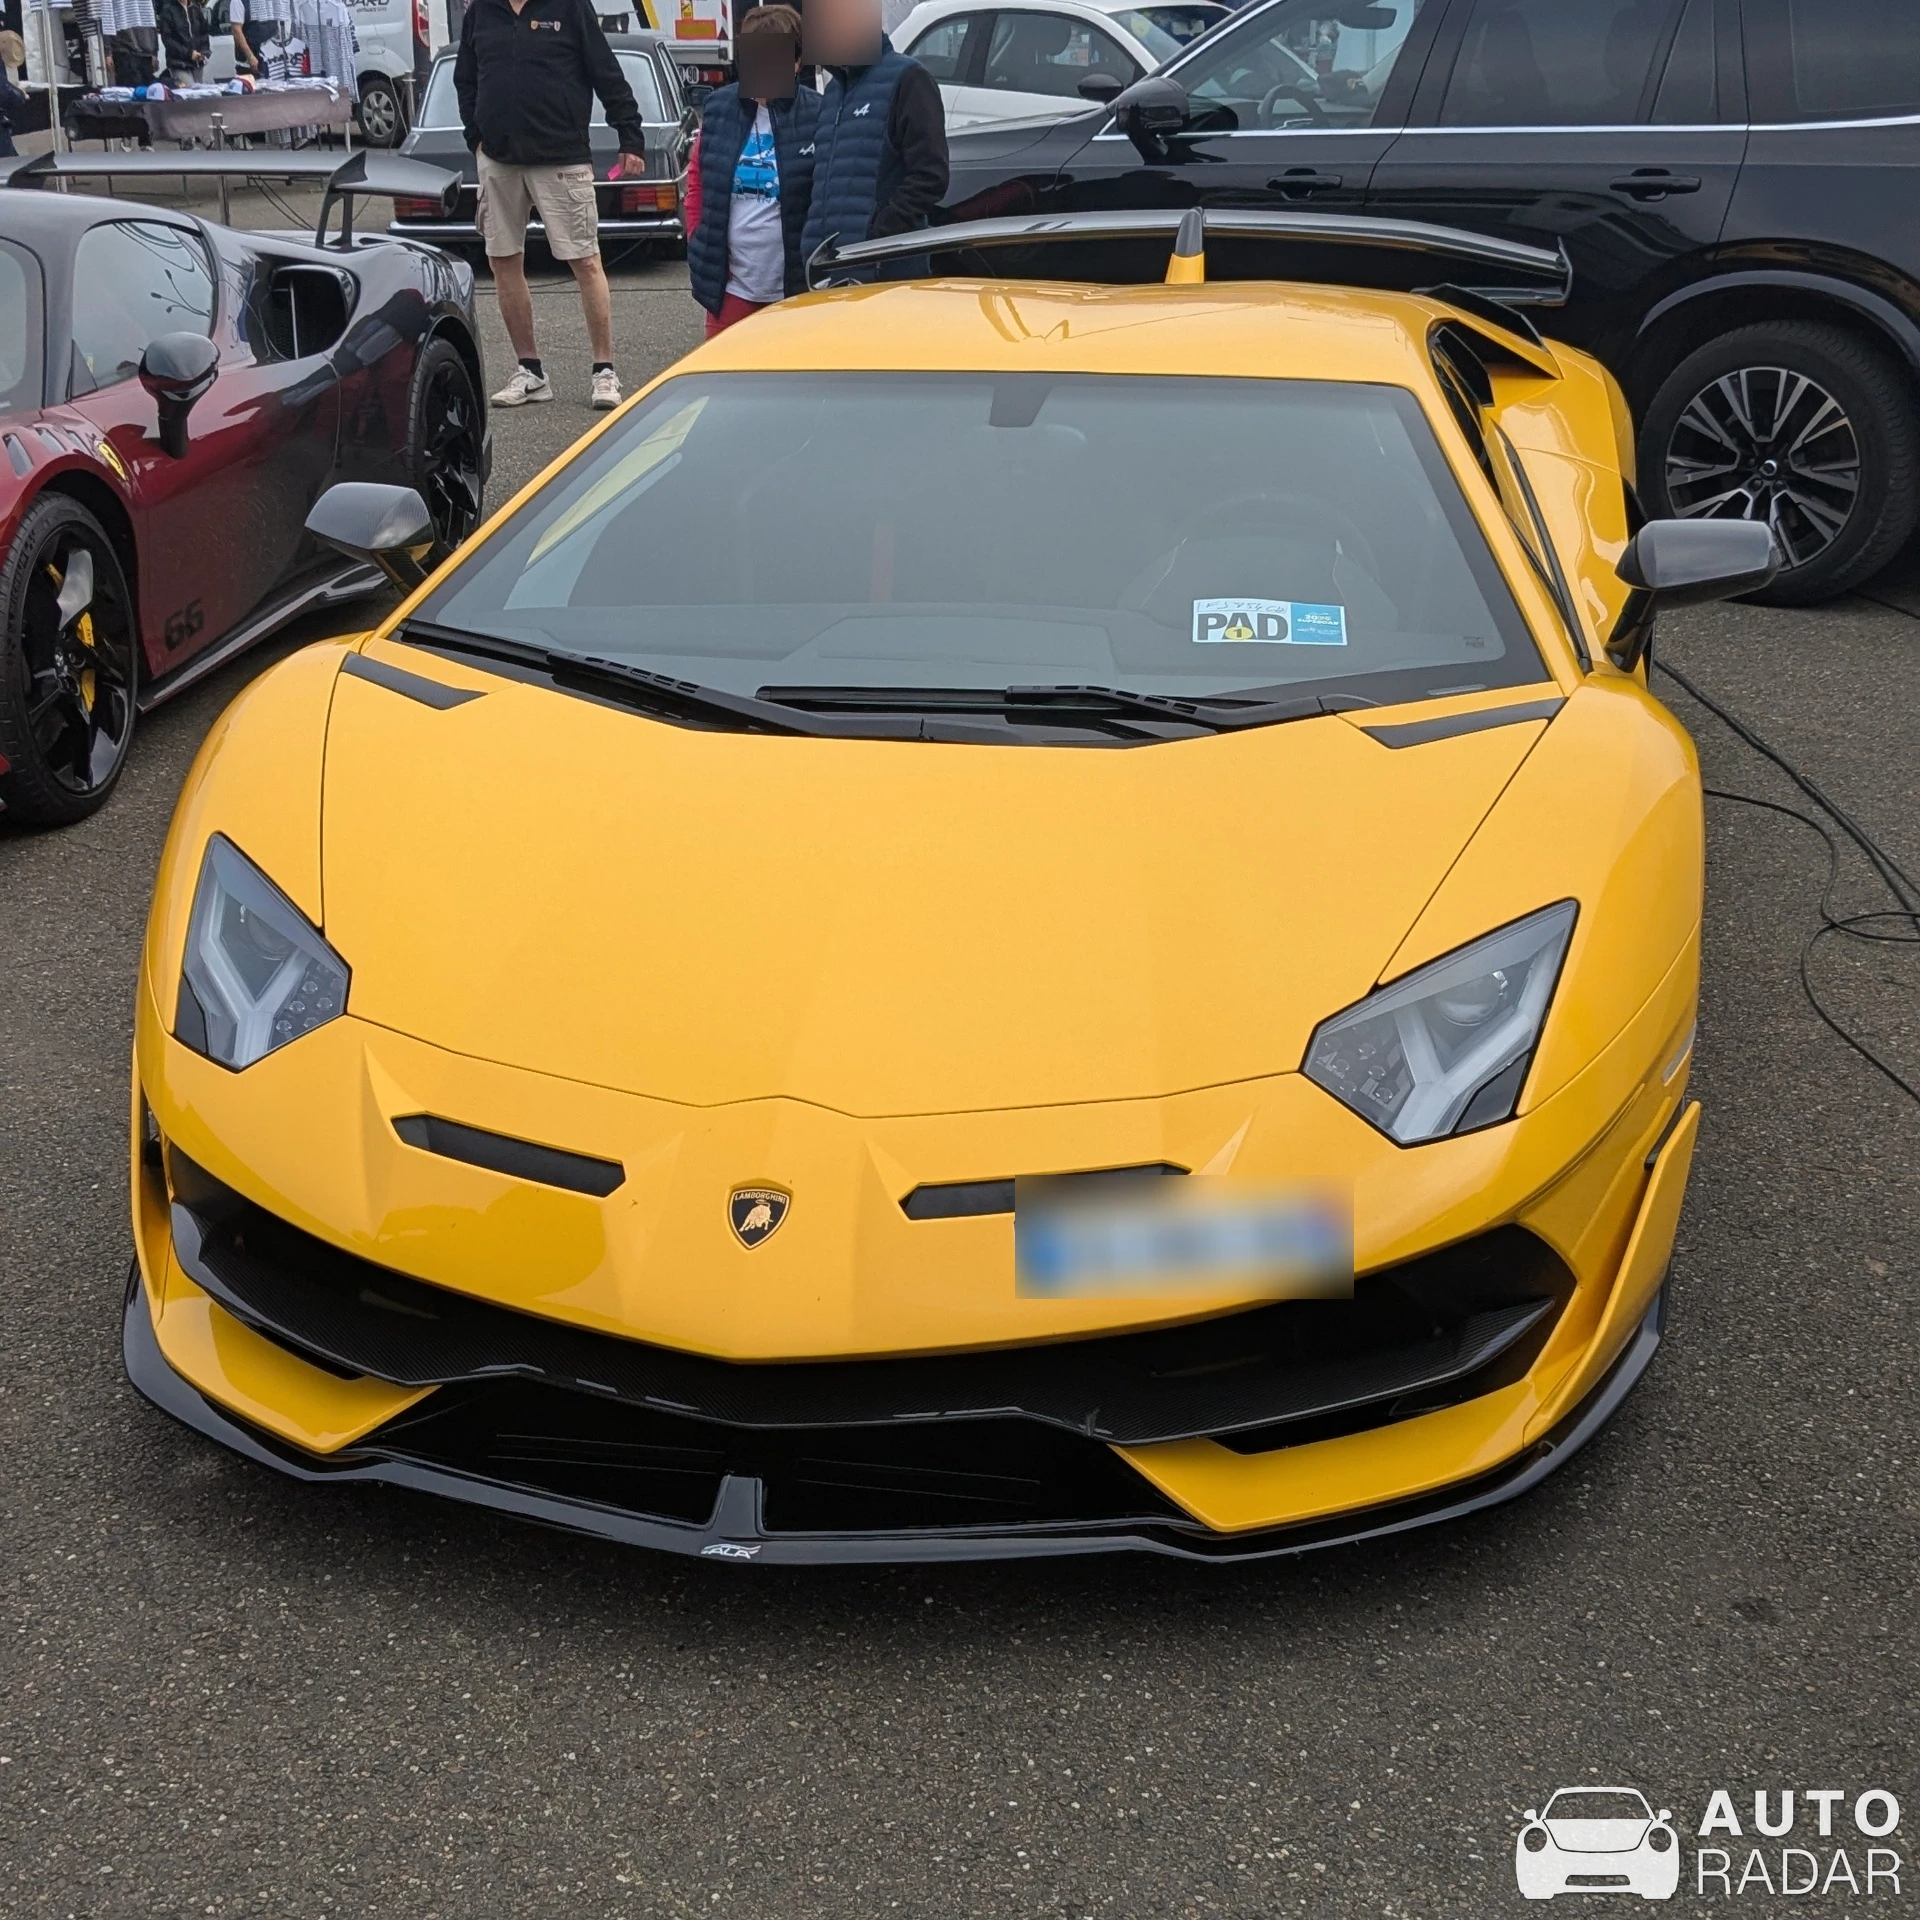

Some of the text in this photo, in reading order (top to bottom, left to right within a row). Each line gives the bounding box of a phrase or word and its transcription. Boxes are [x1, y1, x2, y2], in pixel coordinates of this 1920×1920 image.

[688, 67, 698, 82] 90
[1197, 612, 1289, 641] PAD
[735, 1191, 786, 1204] LAMBORGHINI
